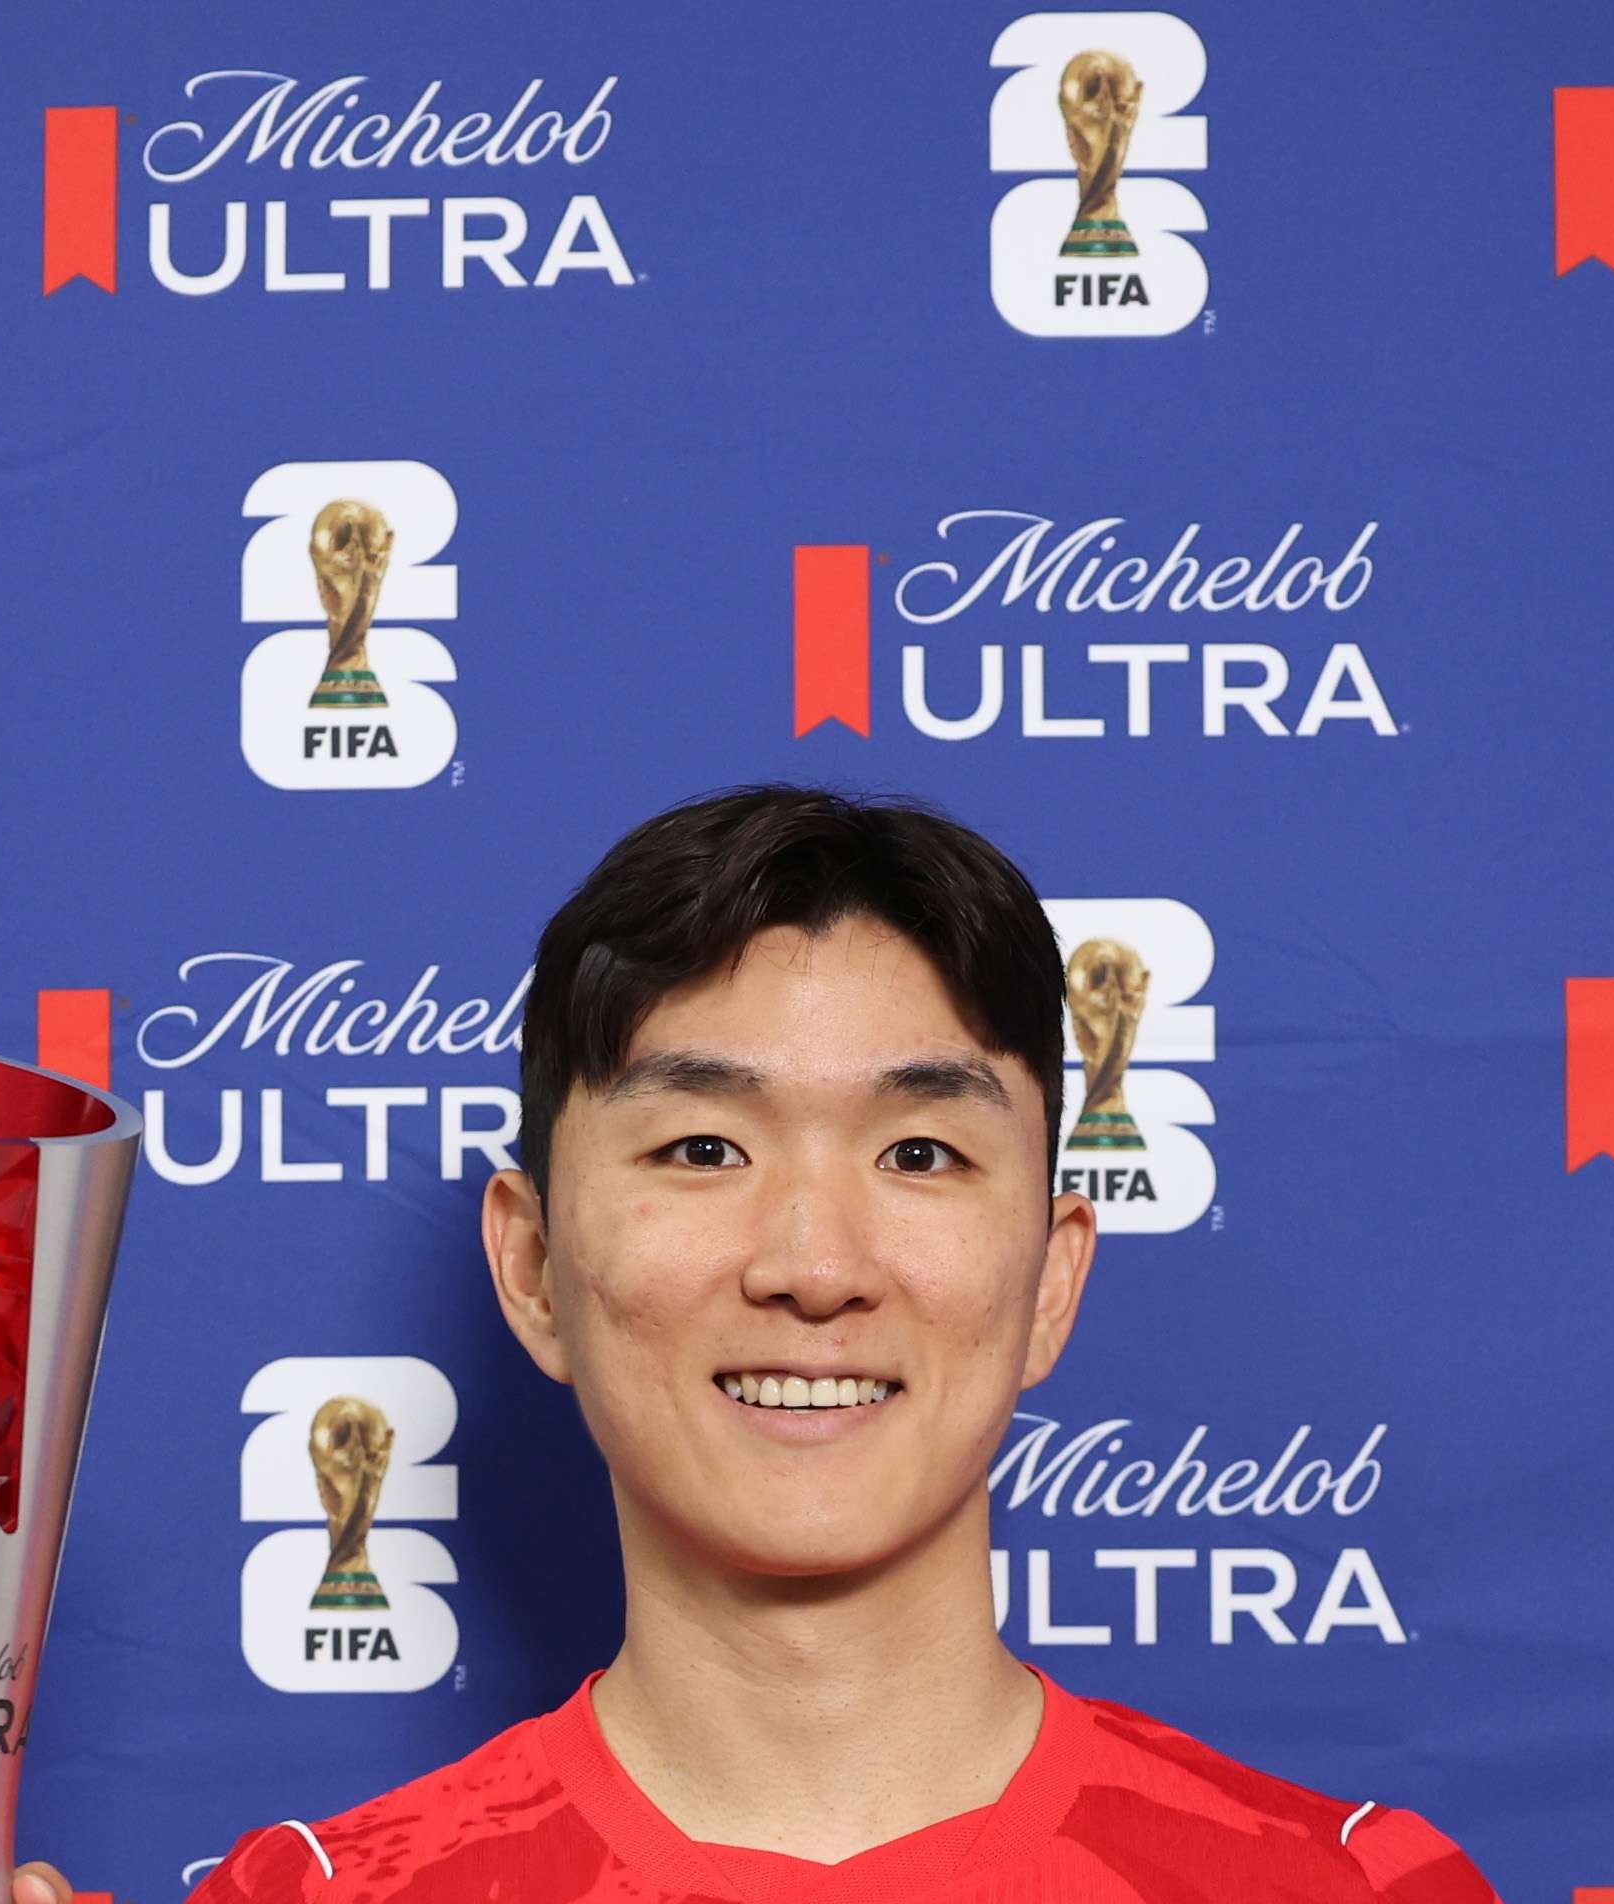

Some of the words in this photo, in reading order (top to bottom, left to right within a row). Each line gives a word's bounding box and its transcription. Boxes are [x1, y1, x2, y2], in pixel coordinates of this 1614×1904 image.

[143, 70, 618, 183] Michelob
[149, 195, 635, 296] ULTRA
[1055, 274, 1150, 307] FIFA
[895, 510, 1378, 624] Michelob
[304, 725, 398, 759] FIFA
[902, 643, 1399, 741] ULTRA
[136, 952, 538, 1069] Michel
[143, 1086, 524, 1186] ULTR
[305, 1628, 400, 1661] FIFA
